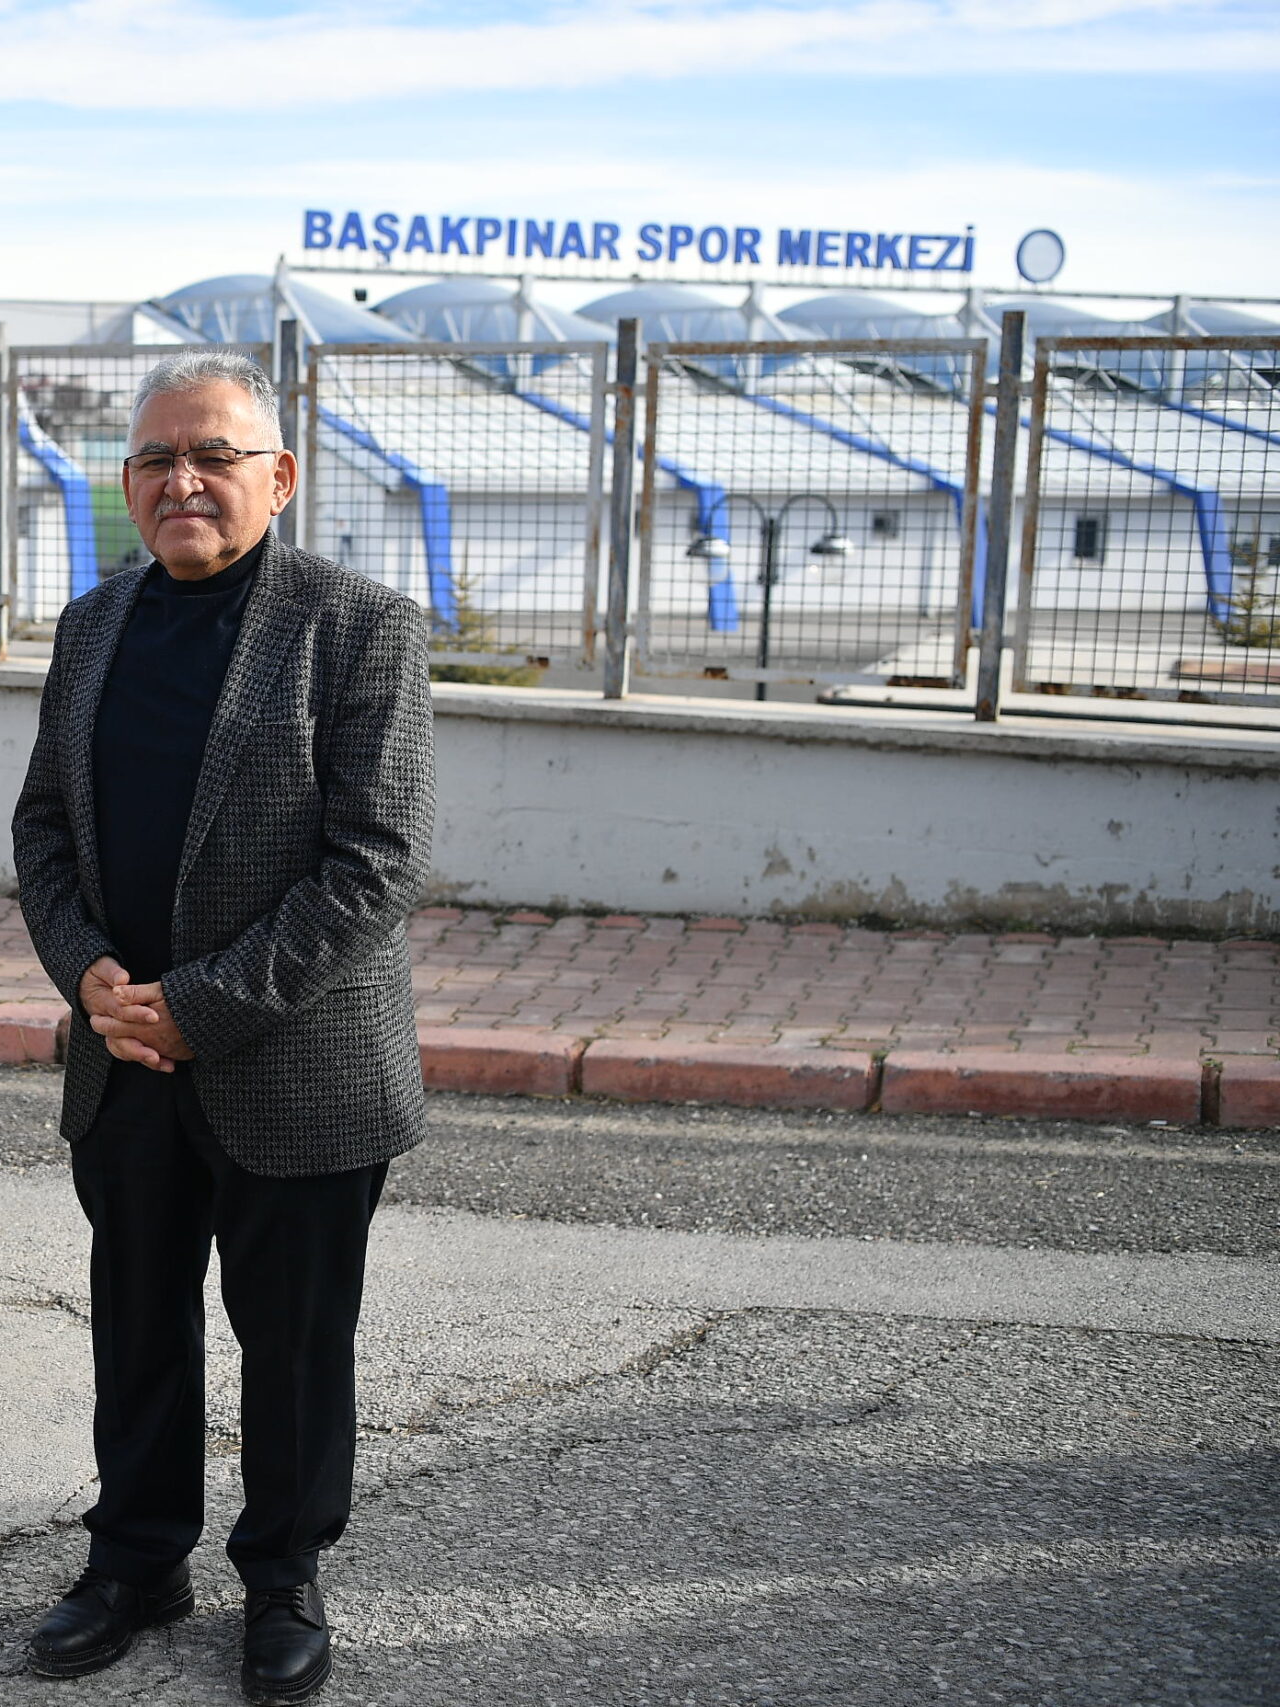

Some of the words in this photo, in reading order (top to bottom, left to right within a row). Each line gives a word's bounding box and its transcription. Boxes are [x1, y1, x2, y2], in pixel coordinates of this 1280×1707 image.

[304, 210, 620, 264] BAŞAKPINAR
[638, 223, 761, 264] SPOR
[777, 225, 976, 272] MERKEZİ
